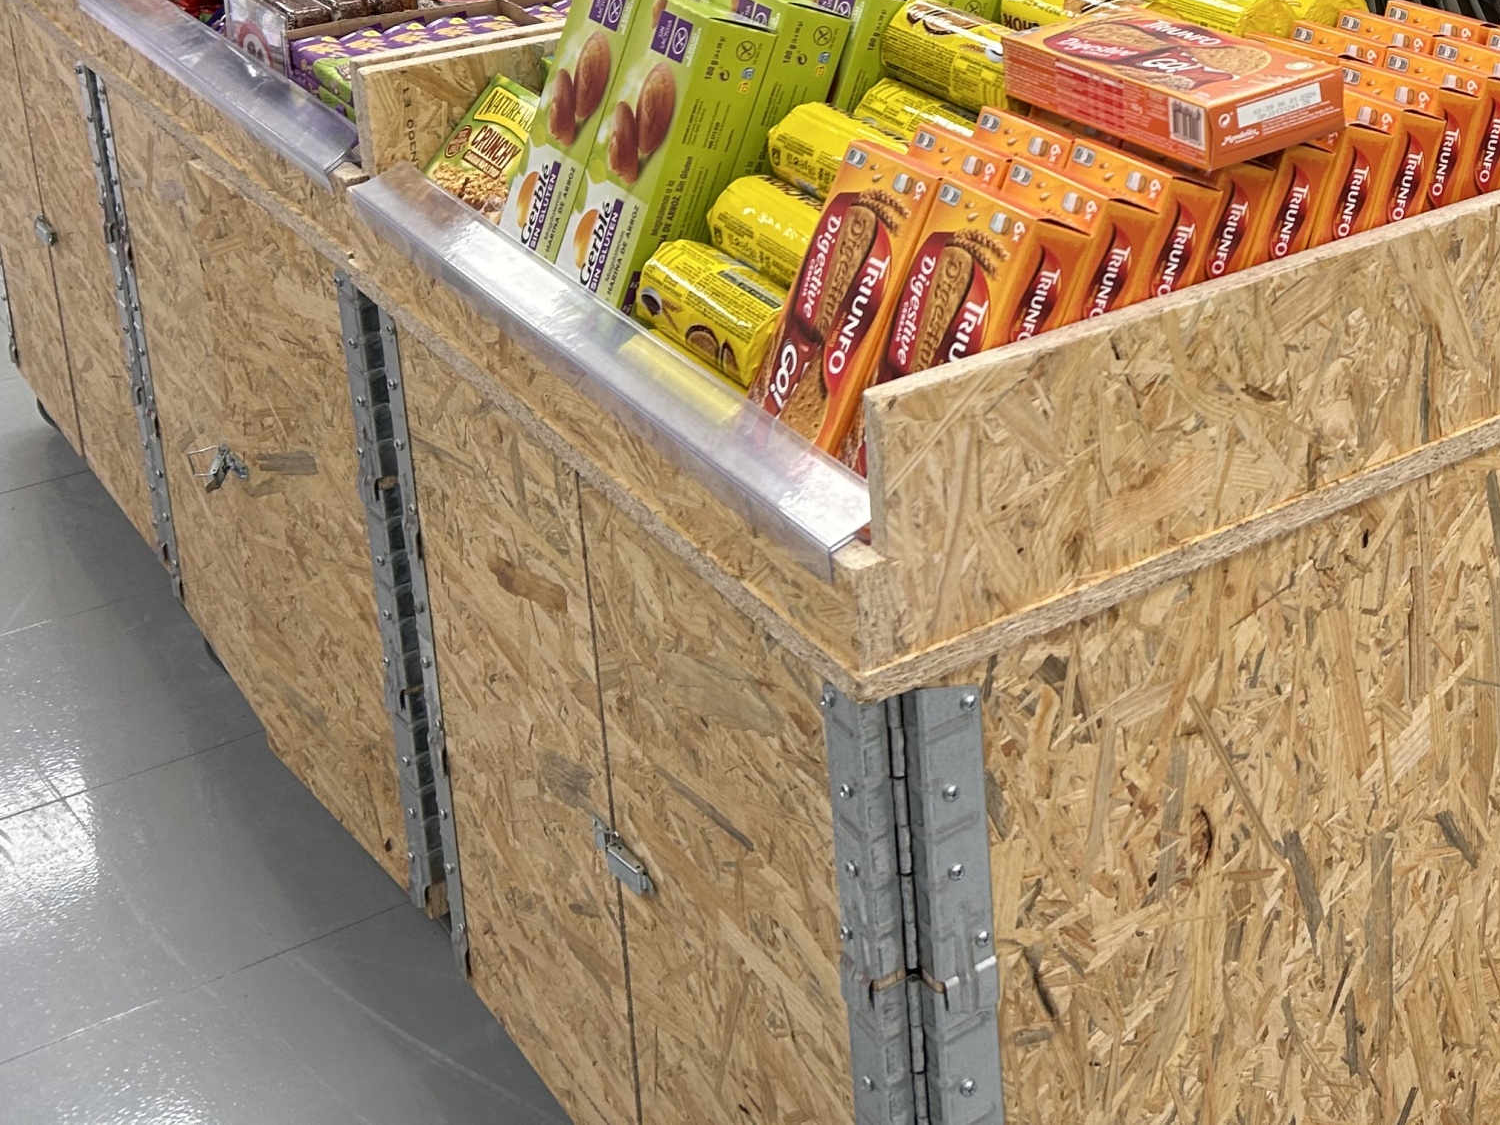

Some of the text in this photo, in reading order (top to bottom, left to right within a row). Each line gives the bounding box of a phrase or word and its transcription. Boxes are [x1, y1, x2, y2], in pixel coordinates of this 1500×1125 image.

[1145, 19, 1222, 47] TRIUNFO
[1412, 37, 1424, 54] 6x
[1460, 26, 1472, 42] 6x
[1365, 48, 1378, 68] 6x
[478, 89, 522, 123] NATURE
[1418, 90, 1431, 110] 6x
[1466, 79, 1479, 98] 6x
[1381, 112, 1394, 132] 6x
[470, 125, 522, 170] CRUNCHY
[1049, 143, 1063, 163] 6x
[1430, 126, 1461, 197] TRIUNFO
[561, 166, 577, 204] ARROZ
[914, 181, 928, 202] 6x
[984, 162, 997, 183] 6x
[1148, 178, 1162, 199] 6x
[1391, 150, 1424, 221] TRIUNFO
[521, 163, 550, 246] Gerblé
[529, 173, 558, 251] SIN GLUTEN
[1085, 199, 1098, 221] 6x
[1274, 181, 1311, 258] TRIUNFO
[1335, 164, 1371, 238] TRIUNFO
[579, 200, 612, 287] Gerblé
[624, 204, 641, 242] ARROZ
[1012, 220, 1027, 243] 6x
[1210, 200, 1250, 276] TRIUNFO
[588, 211, 620, 293] SIN GLUTEN
[801, 213, 844, 320] Digestive
[1156, 221, 1197, 298] TRIUNFO
[828, 255, 892, 375] TRIUNFO
[896, 253, 938, 366] Digestive
[947, 298, 990, 363] TRIU
[772, 343, 798, 411] GO!
